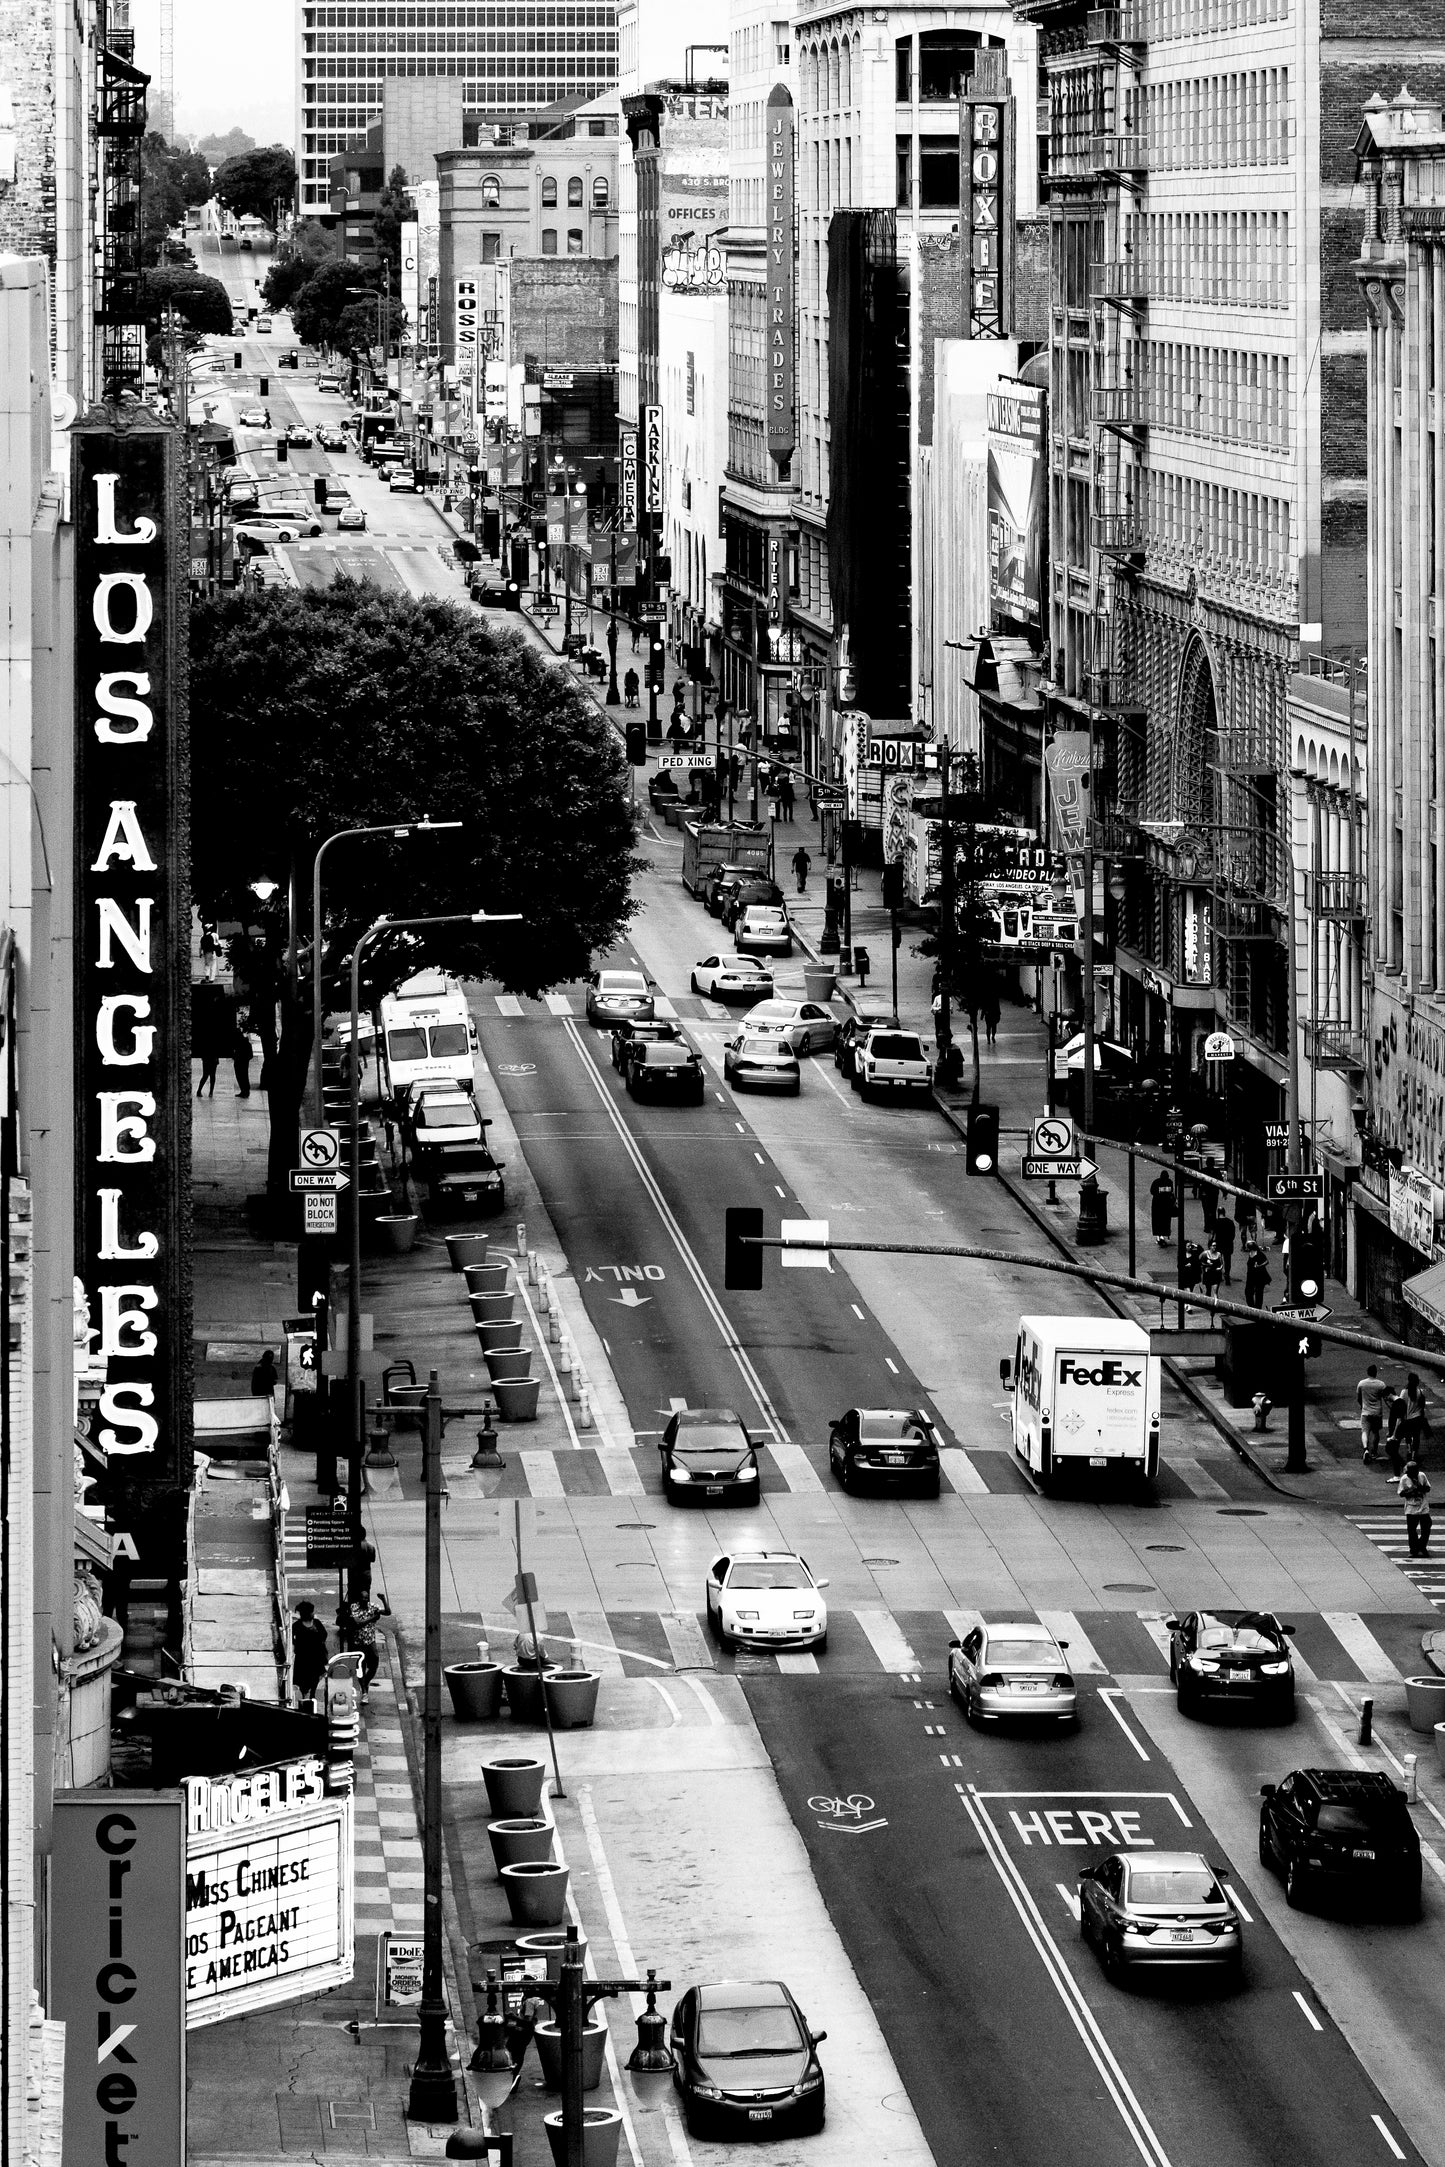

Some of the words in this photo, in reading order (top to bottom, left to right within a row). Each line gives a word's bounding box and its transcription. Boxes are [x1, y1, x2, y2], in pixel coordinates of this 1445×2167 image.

[682, 178, 700, 186] 430
[770, 119, 784, 266] JEWELRY
[668, 207, 716, 219] OFFICES
[972, 106, 999, 309] ROXIE
[458, 282, 477, 342] ROSS
[772, 285, 785, 412] TRADES
[648, 408, 660, 507] PARKING
[622, 444, 635, 519] CAMERA
[593, 565, 609, 574] NEXT
[769, 540, 779, 584] RITE
[593, 573, 609, 582] FEST
[92, 472, 158, 744] LOS
[532, 606, 544, 614] ONE
[769, 587, 779, 618] AID
[662, 757, 684, 767] PED
[687, 757, 712, 767] XING
[817, 787, 831, 796] 5th
[1203, 906, 1211, 945] FULL
[1203, 952, 1211, 982] BAR
[90, 800, 160, 1456] ANGELES
[297, 1176, 315, 1185] ONE
[317, 1176, 336, 1185] WAY
[1027, 1162, 1050, 1174] ONE
[1056, 1163, 1080, 1174] WAY
[1275, 1180, 1298, 1195] 6th
[1302, 1180, 1318, 1193] St
[307, 1198, 318, 1207] DO
[319, 1198, 334, 1207] NOT
[307, 1210, 334, 1219] BLOCK
[306, 1221, 335, 1229] INTERSECTION
[584, 1264, 667, 1283] ONLY
[1297, 1309, 1316, 1319] WAY
[1059, 1359, 1143, 1387] FedEx
[1106, 1388, 1135, 1397] Express
[1008, 1810, 1155, 1846] HERE
[219, 1906, 300, 1950] PAGEANT
[205, 1940, 290, 1985] AMERICAS
[96, 1813, 138, 2167] cricket
